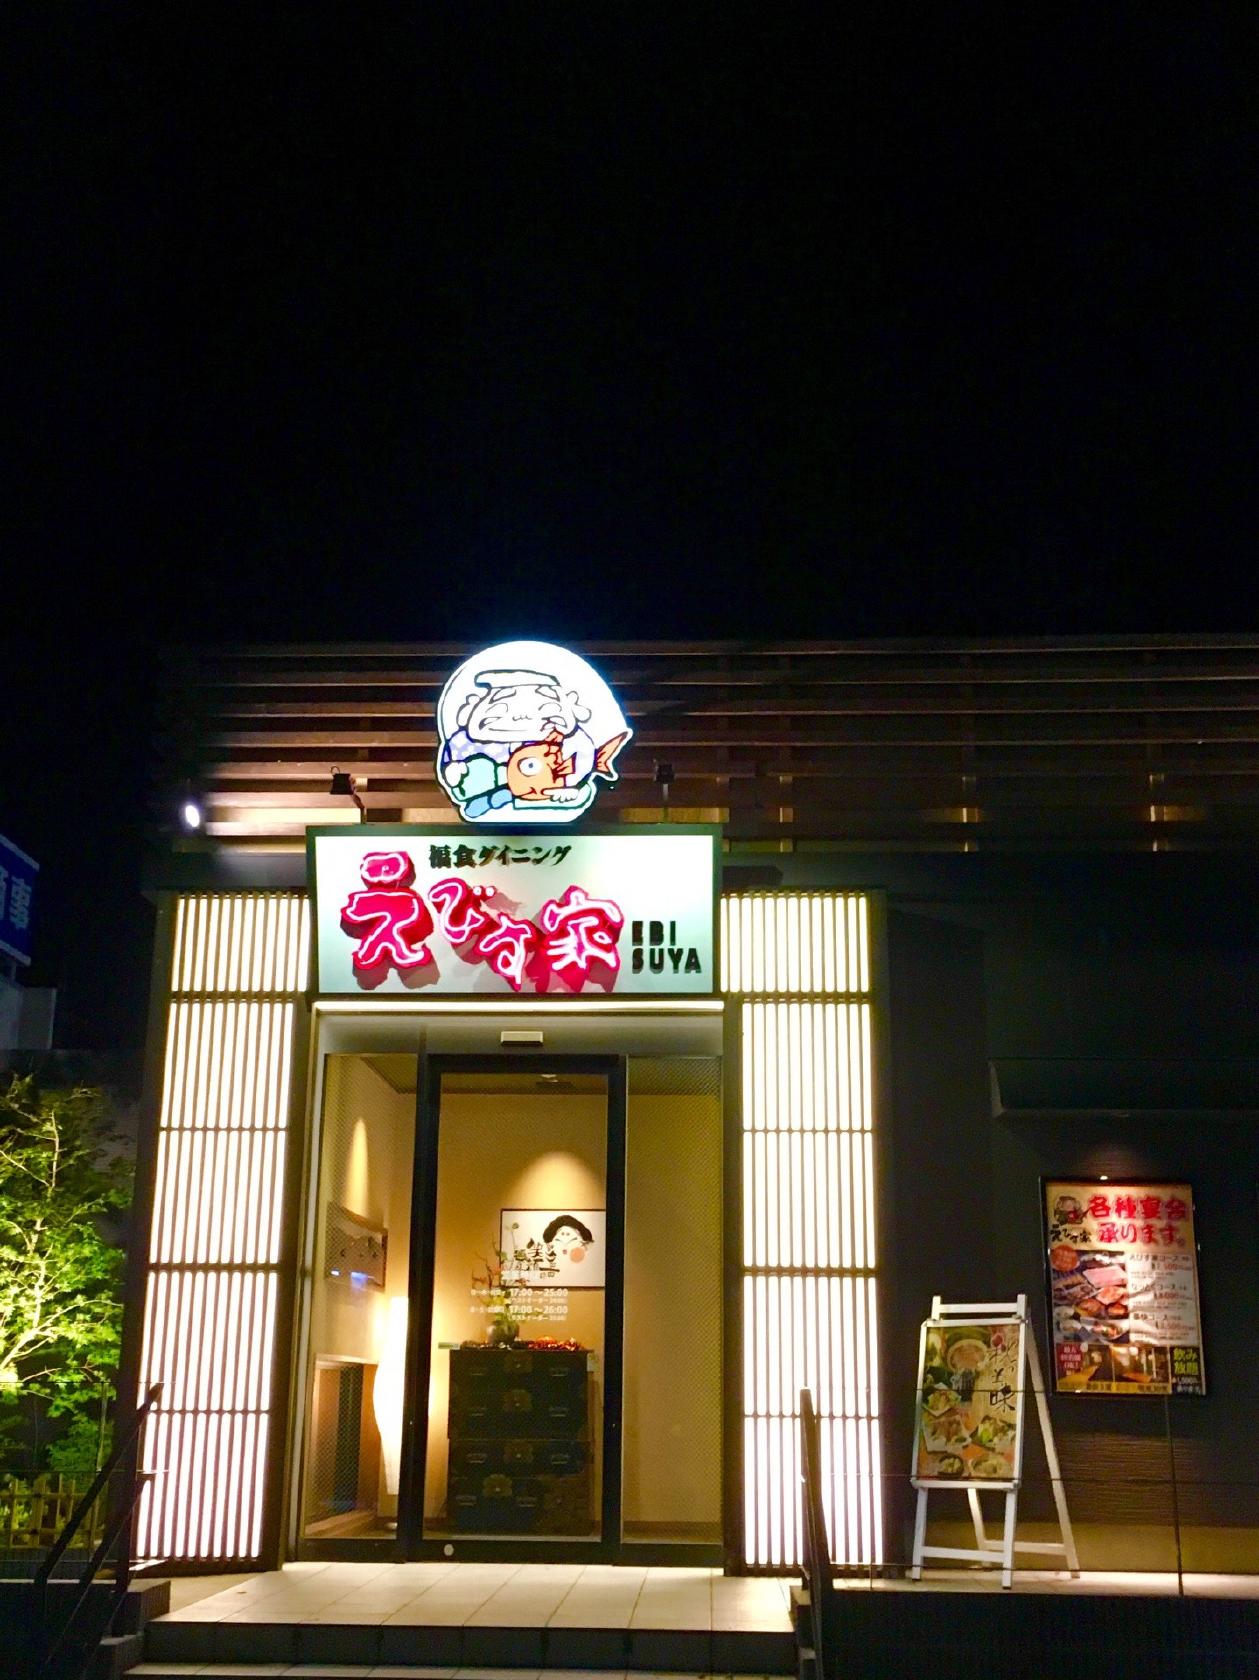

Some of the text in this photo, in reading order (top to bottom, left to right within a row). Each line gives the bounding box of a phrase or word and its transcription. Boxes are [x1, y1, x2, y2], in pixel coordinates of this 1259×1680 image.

[631, 920, 677, 946] EBI
[631, 947, 702, 974] SUYA
[1089, 1194, 1187, 1220] 各種宴会
